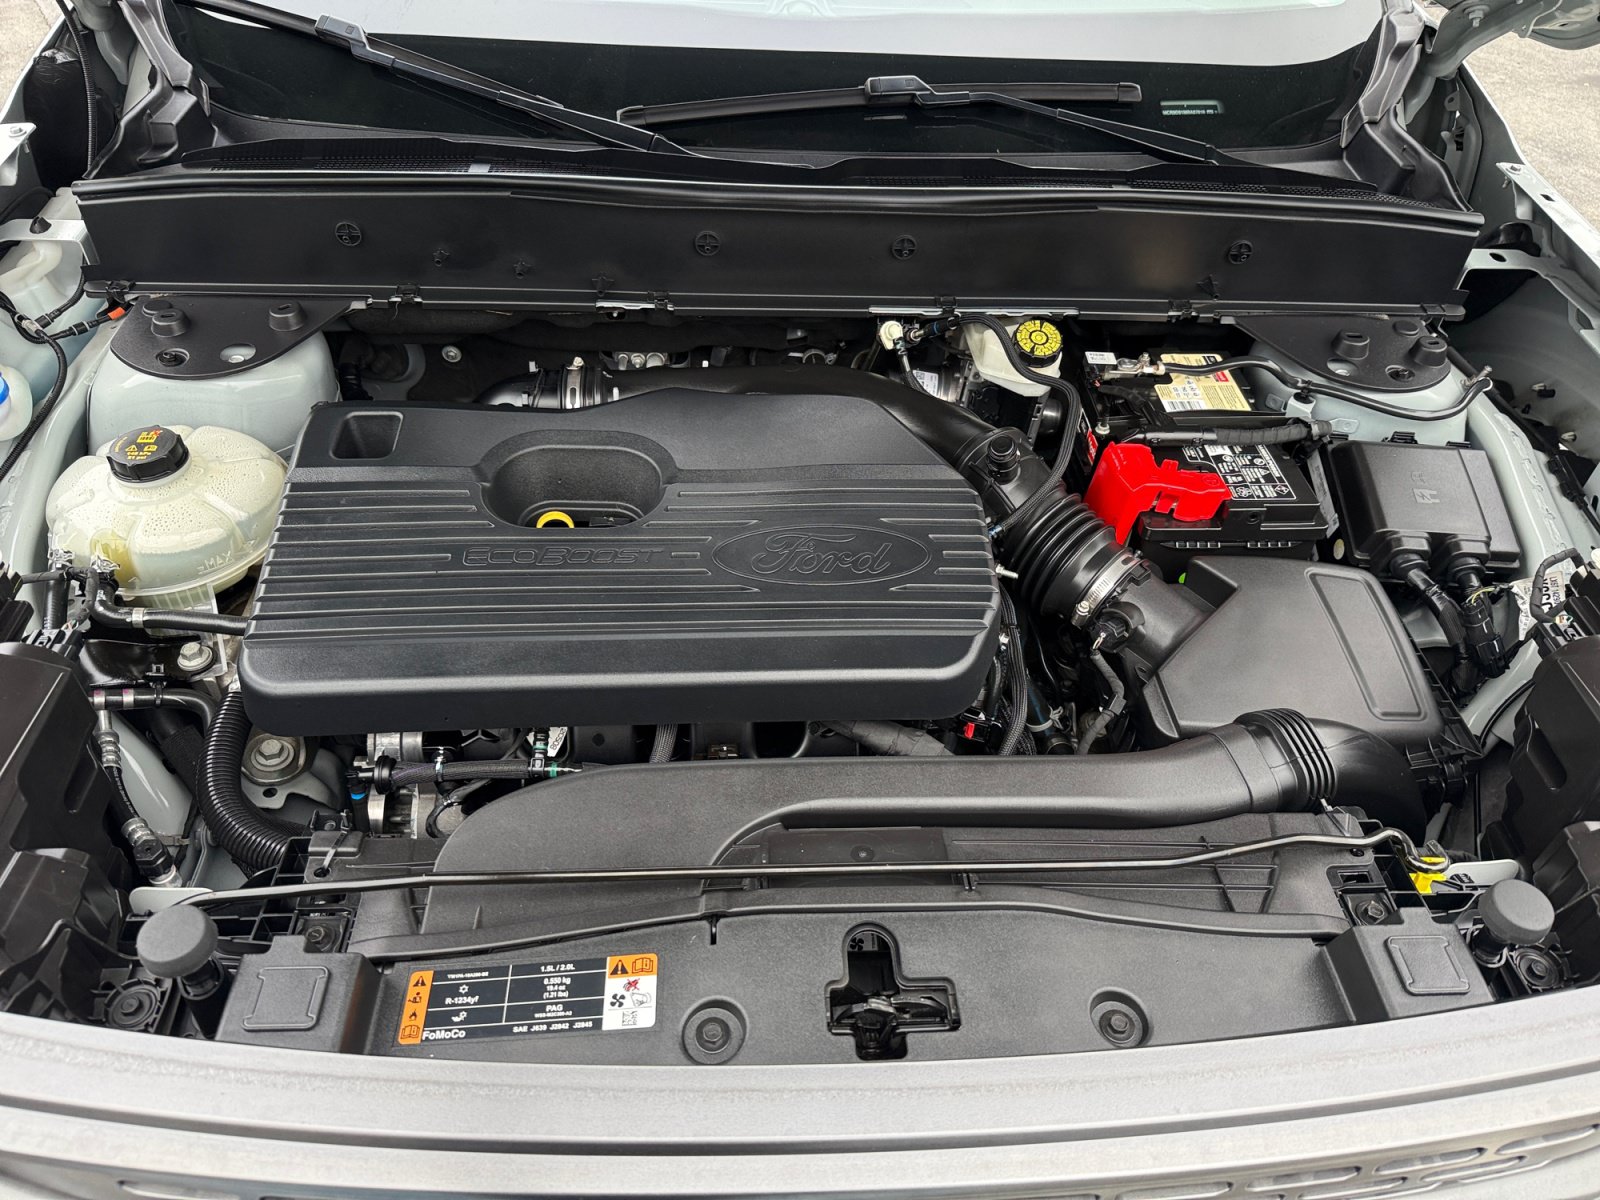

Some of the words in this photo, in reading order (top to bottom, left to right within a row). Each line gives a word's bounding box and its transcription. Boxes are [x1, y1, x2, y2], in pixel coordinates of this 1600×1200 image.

[752, 531, 892, 574] Ford
[204, 551, 233, 570] MAX
[562, 977, 571, 985] kg
[445, 995, 480, 1005] R-1234yf
[546, 1004, 563, 1012] PAG
[512, 1025, 528, 1033] SAE
[422, 1029, 466, 1041] FoMoCo
